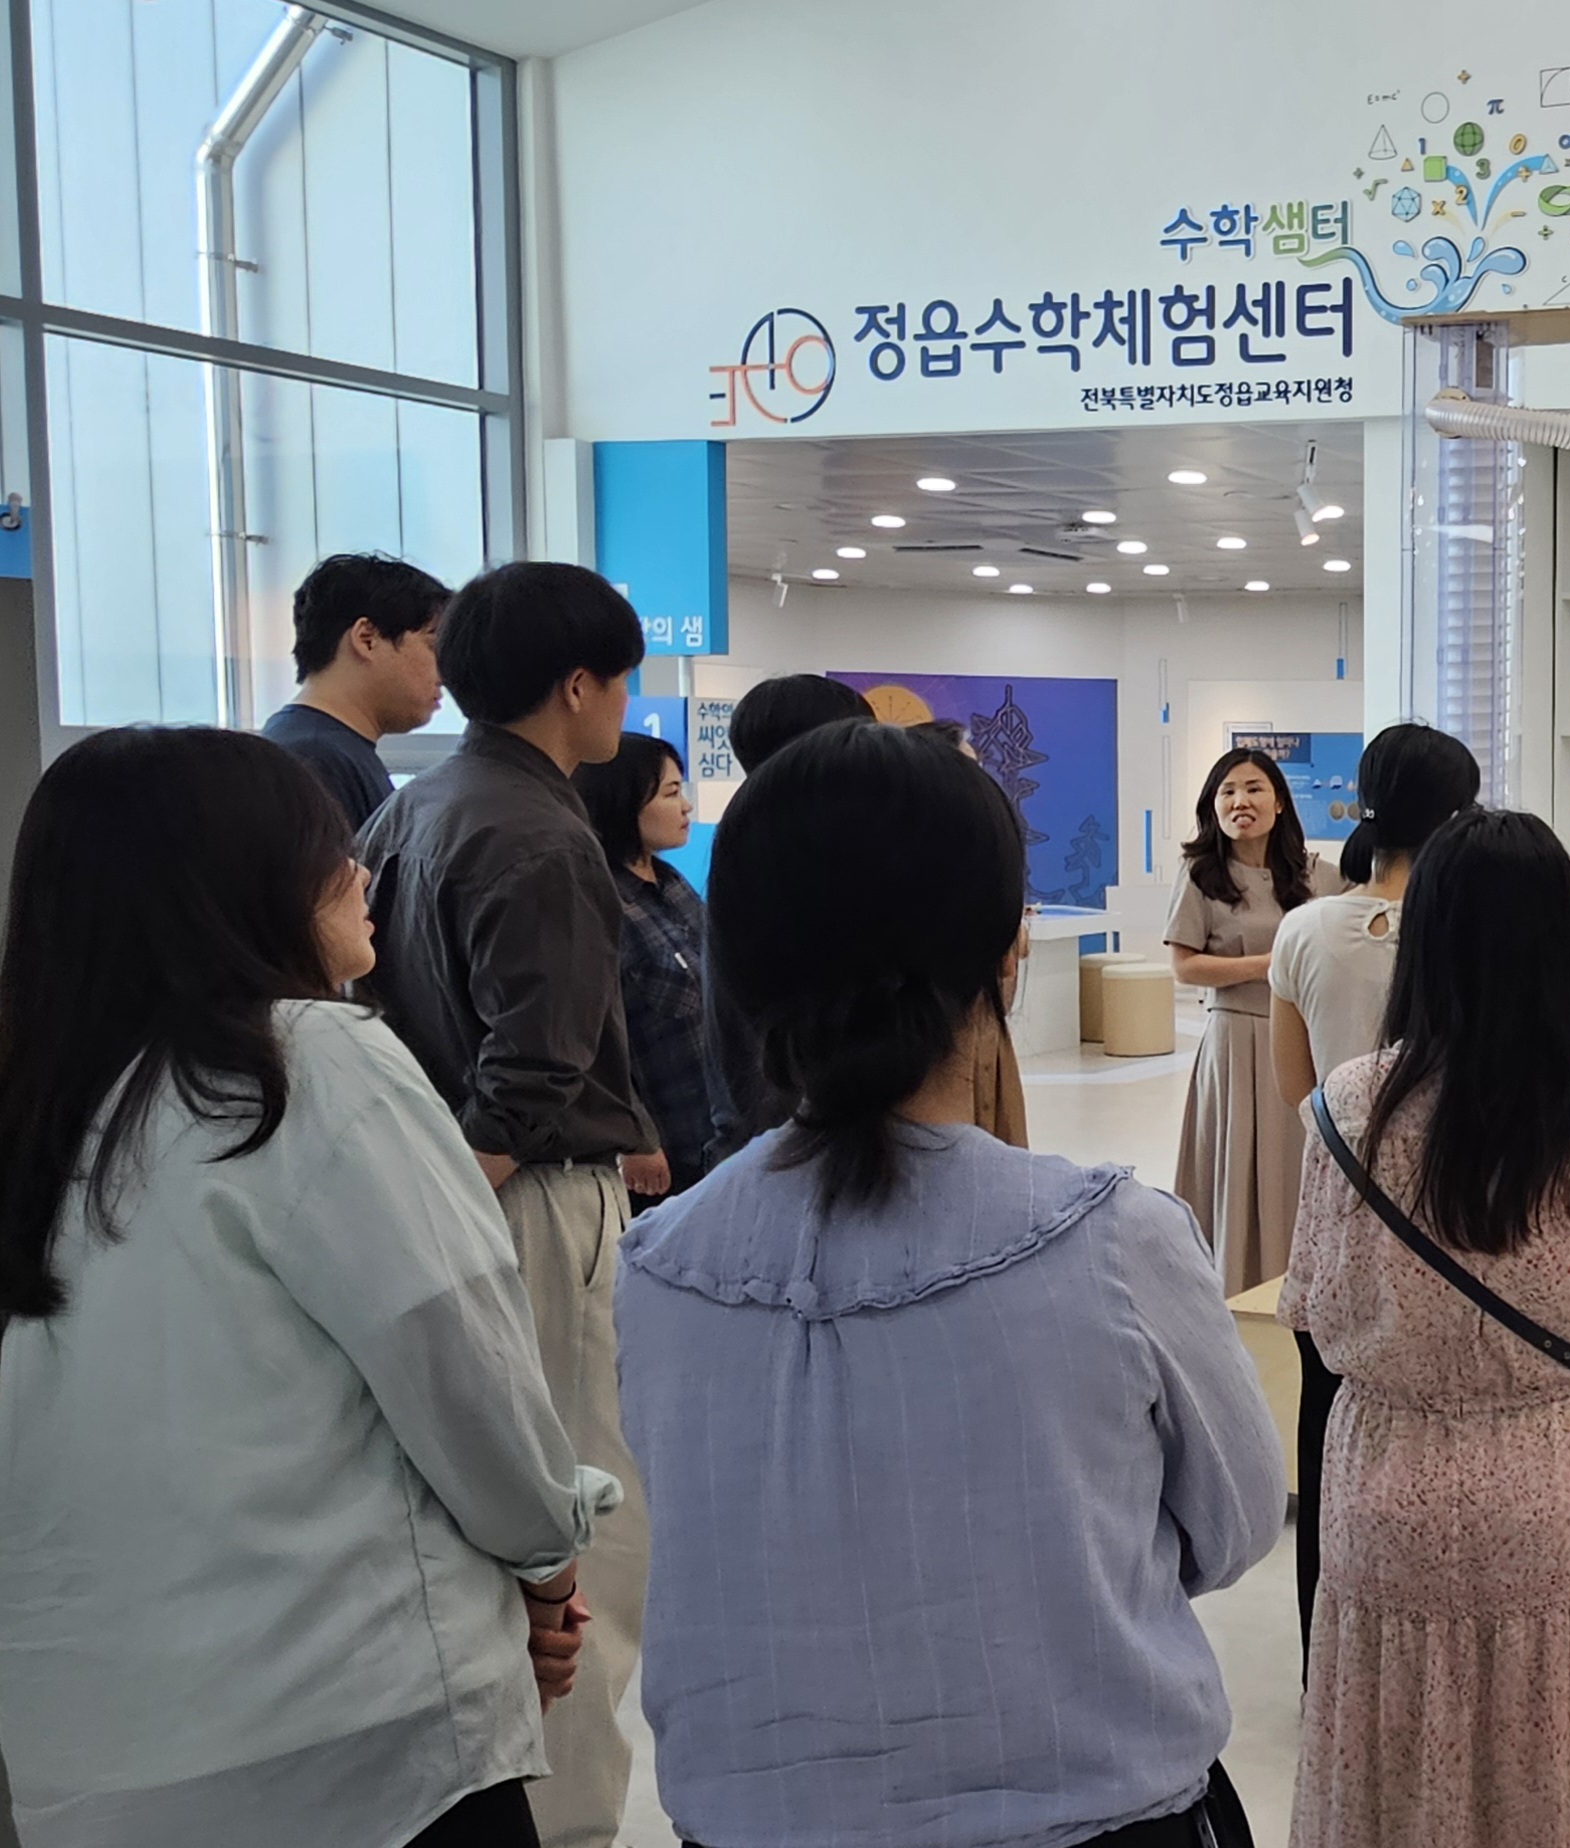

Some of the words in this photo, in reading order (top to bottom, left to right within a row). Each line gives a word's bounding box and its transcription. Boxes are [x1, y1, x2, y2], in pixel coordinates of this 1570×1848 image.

[1475, 158, 1491, 180] 3
[1456, 185, 1468, 205] 2
[1160, 200, 1348, 262] 수학샘터
[854, 276, 1354, 382] 정읍수학체험센터
[1080, 377, 1354, 412] 전북특별자치도정읍교육지원청
[680, 615, 703, 647] 샘
[643, 712, 661, 738] 1
[698, 753, 732, 778] 심다
